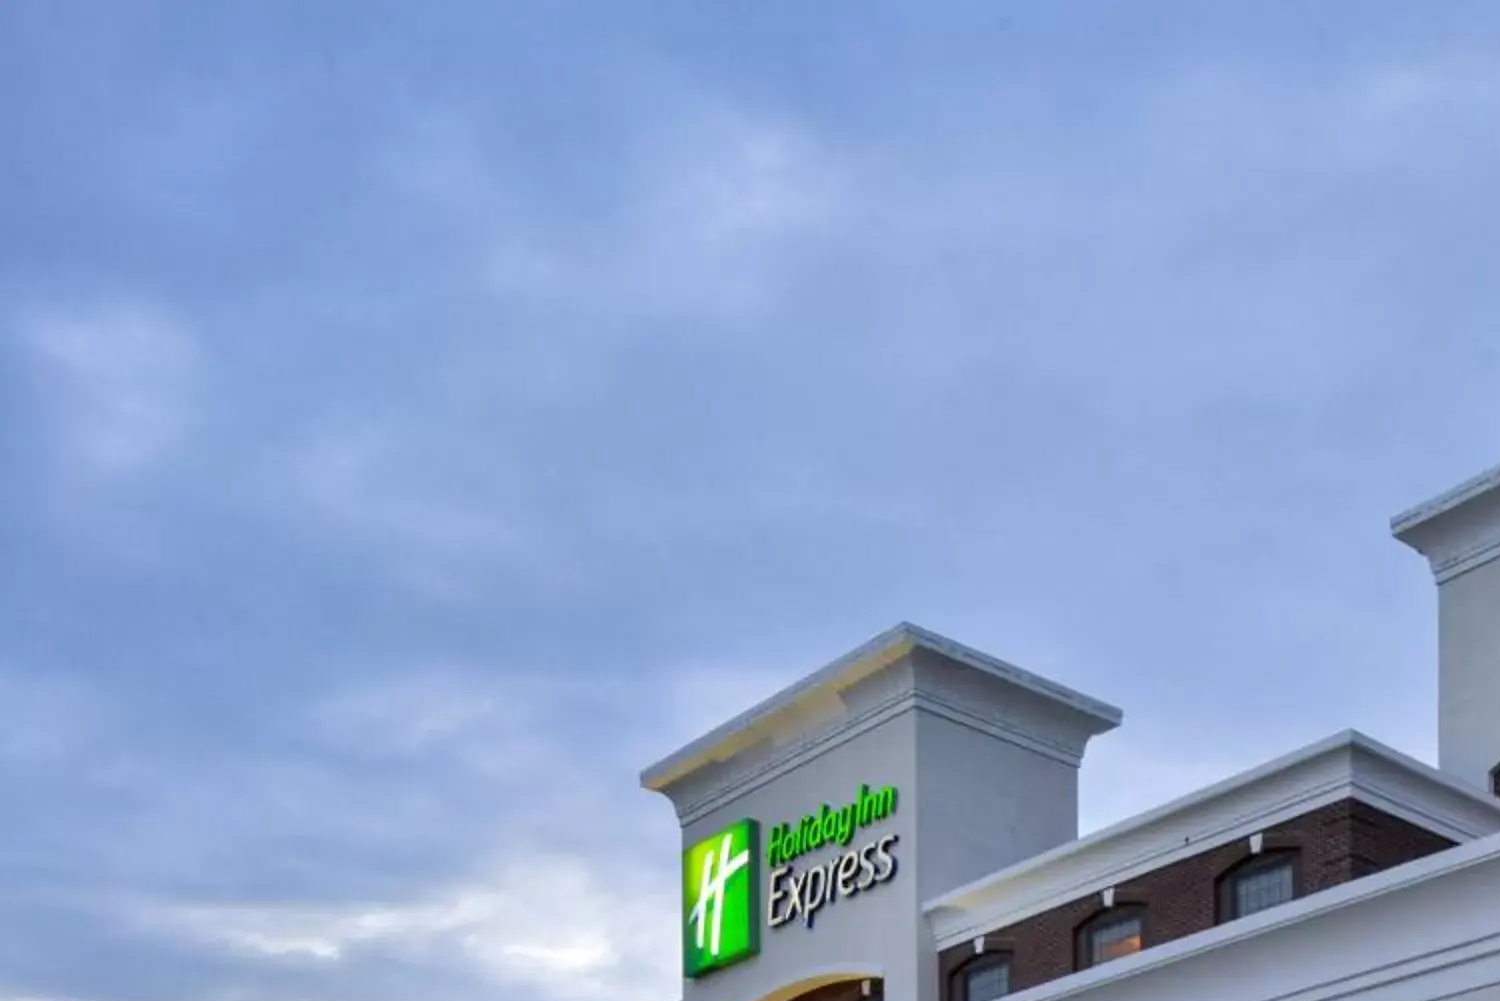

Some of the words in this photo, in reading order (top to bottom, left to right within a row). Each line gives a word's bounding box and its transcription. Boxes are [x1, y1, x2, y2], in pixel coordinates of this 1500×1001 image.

[766, 803, 857, 867] Holiday
[855, 784, 898, 827] Inn
[690, 832, 749, 956] H
[767, 831, 899, 928] Express
